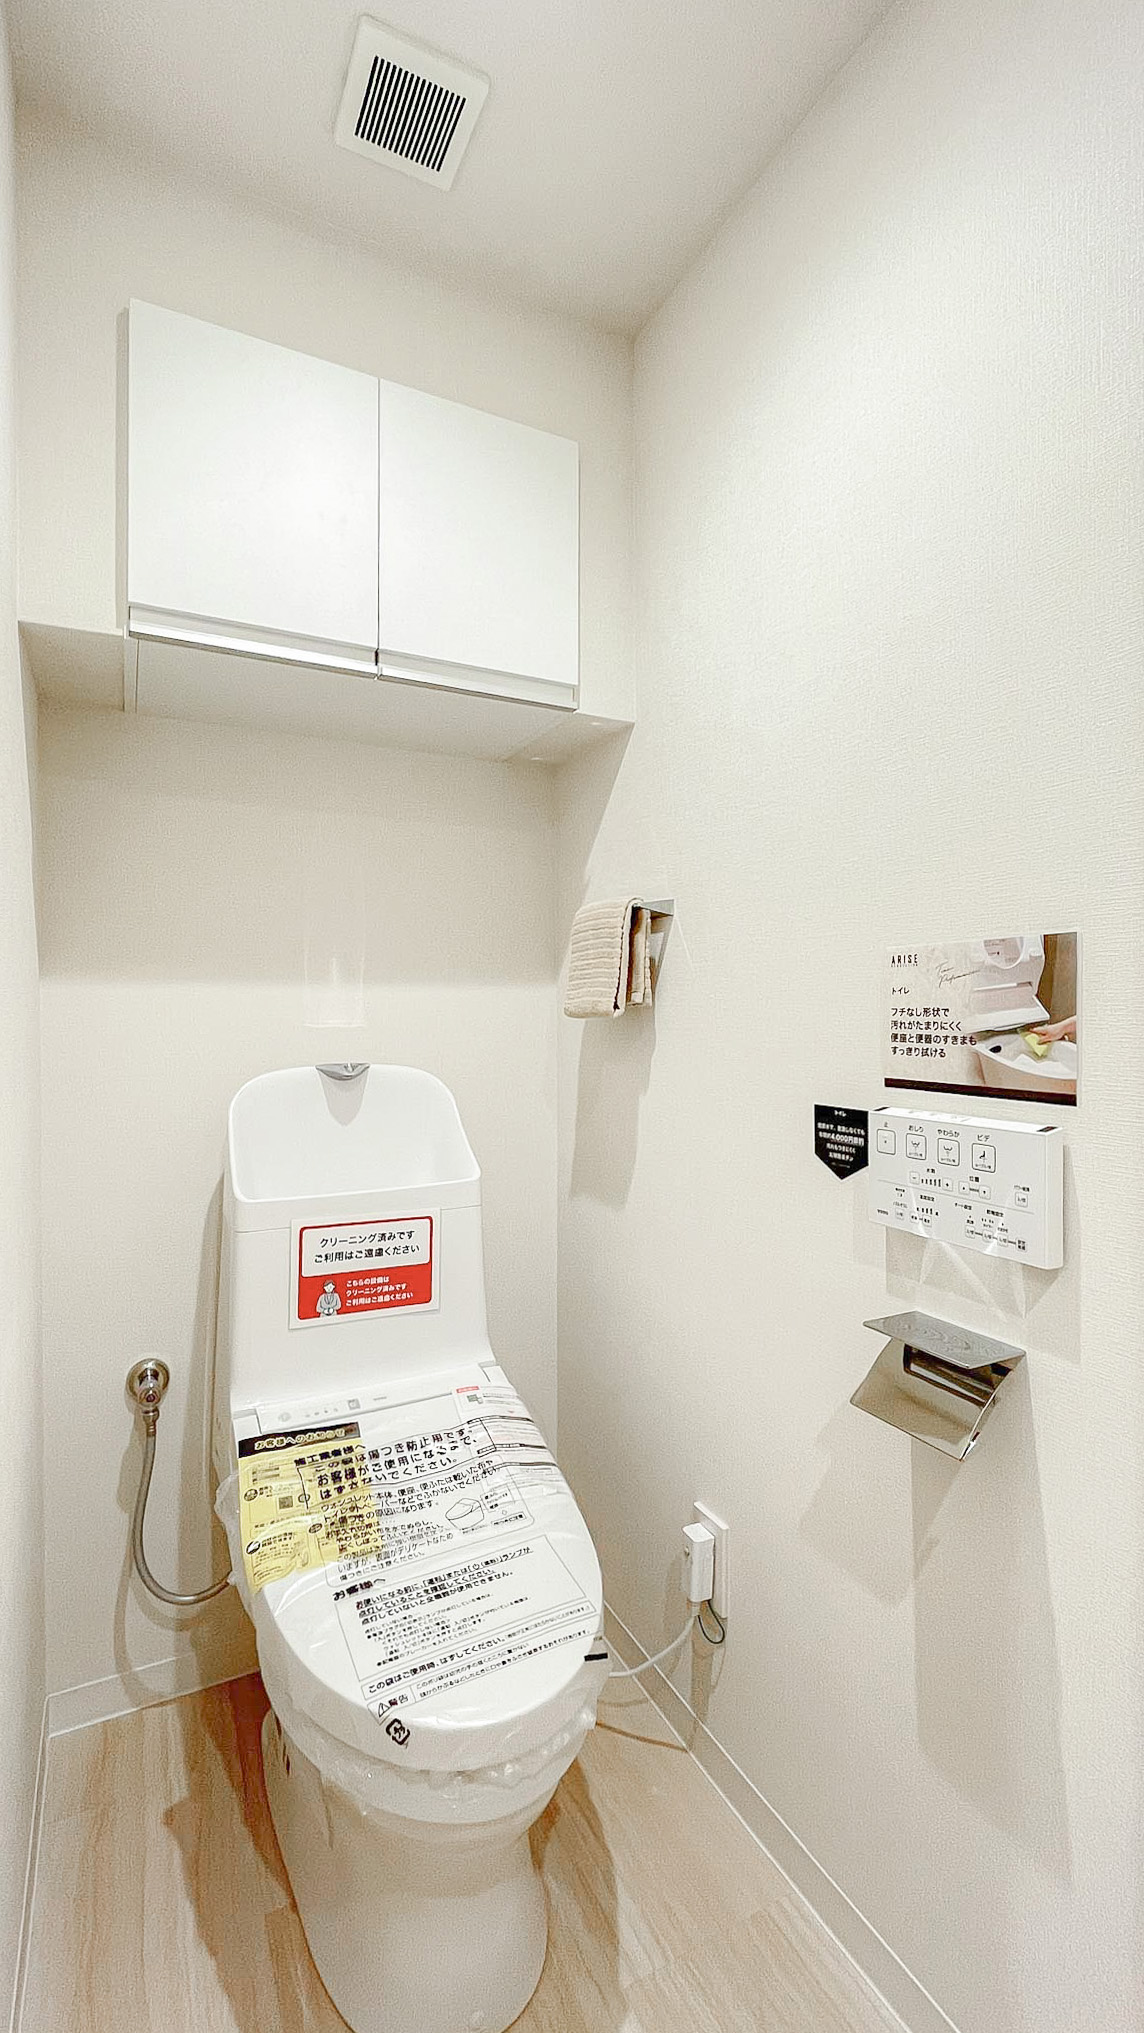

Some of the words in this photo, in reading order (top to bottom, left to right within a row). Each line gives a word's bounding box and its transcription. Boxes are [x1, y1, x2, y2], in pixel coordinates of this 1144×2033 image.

[891, 953, 918, 964] ARISE
[892, 986, 909, 995] トイレ
[890, 1006, 950, 1018] フチなし形状で
[890, 1020, 962, 1032] 汚れがたまりにくく
[890, 1033, 977, 1046] 便座と便器のすきまも
[890, 1045, 946, 1058] すっきり拭ける
[908, 1124, 924, 1133] おしり
[977, 1134, 990, 1142] ビデ
[320, 1230, 415, 1248] クリーニング済みです
[314, 1244, 420, 1263] ご利用はご遠慮ください
[345, 1284, 408, 1297] クリーニング済みです
